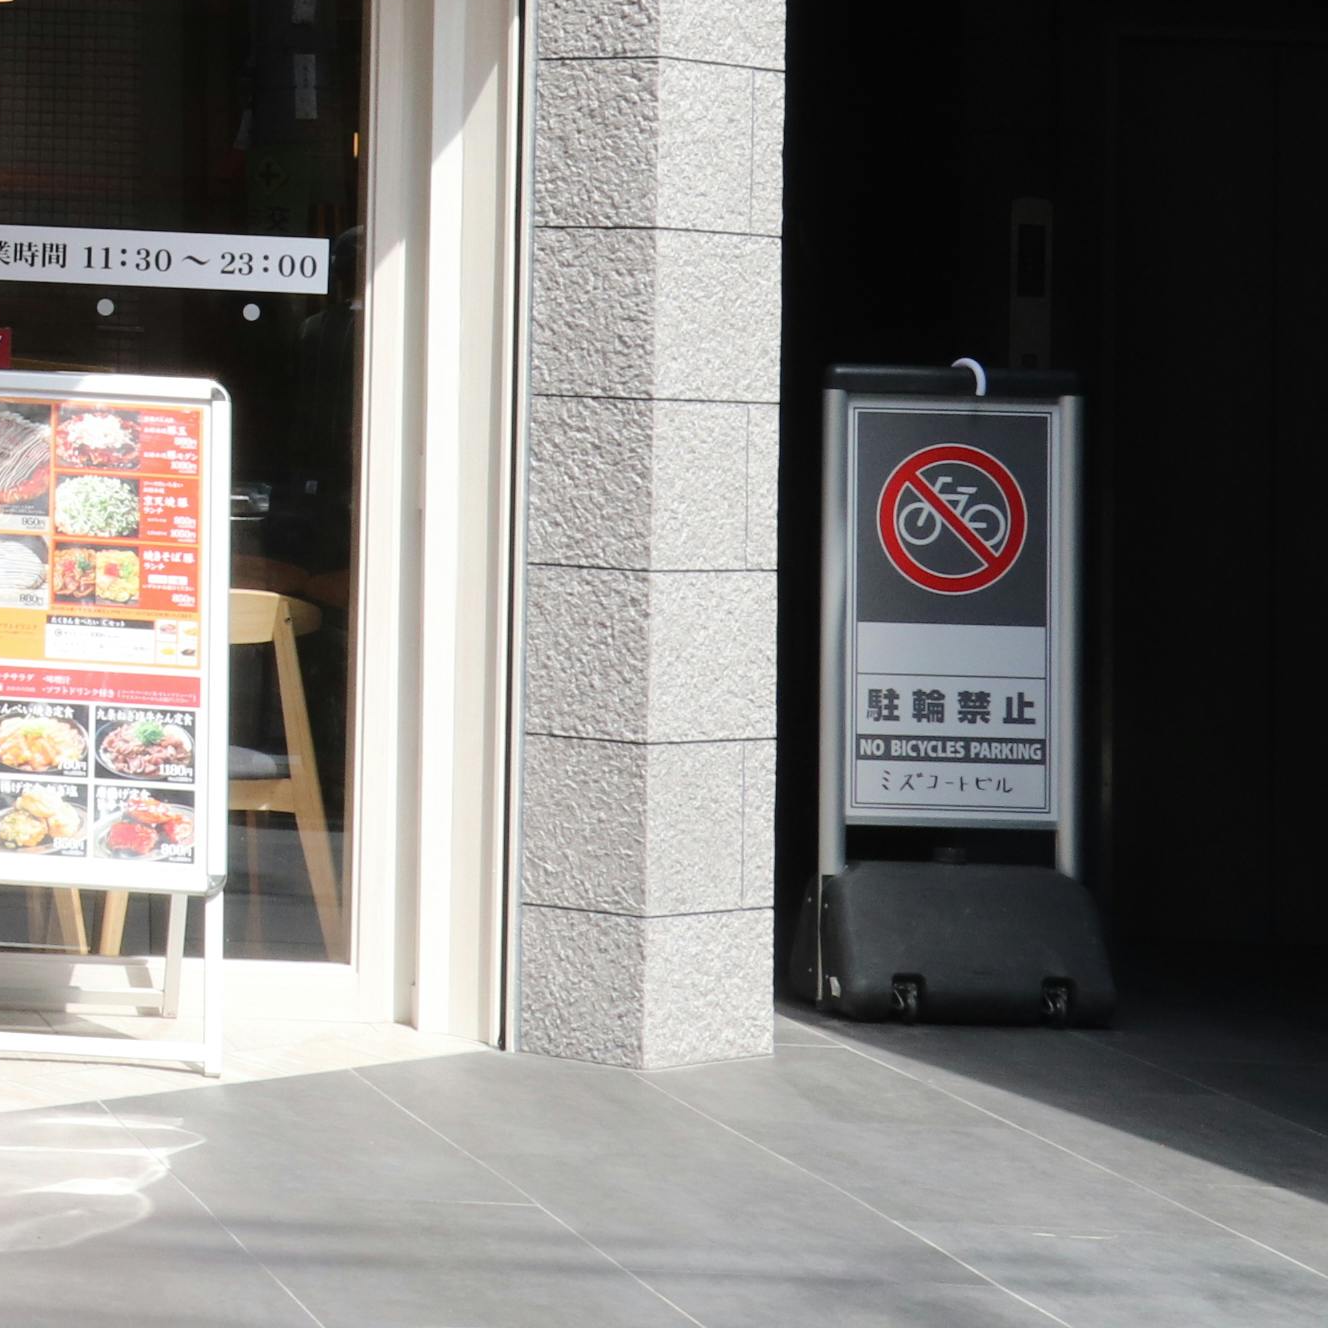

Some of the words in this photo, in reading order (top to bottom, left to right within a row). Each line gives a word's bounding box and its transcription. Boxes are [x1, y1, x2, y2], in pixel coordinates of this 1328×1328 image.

[866, 688, 1036, 725] 駐輪禁止
[859, 738, 885, 756] NO
[890, 739, 965, 759] BICYCLES
[970, 741, 1042, 760] PARKING
